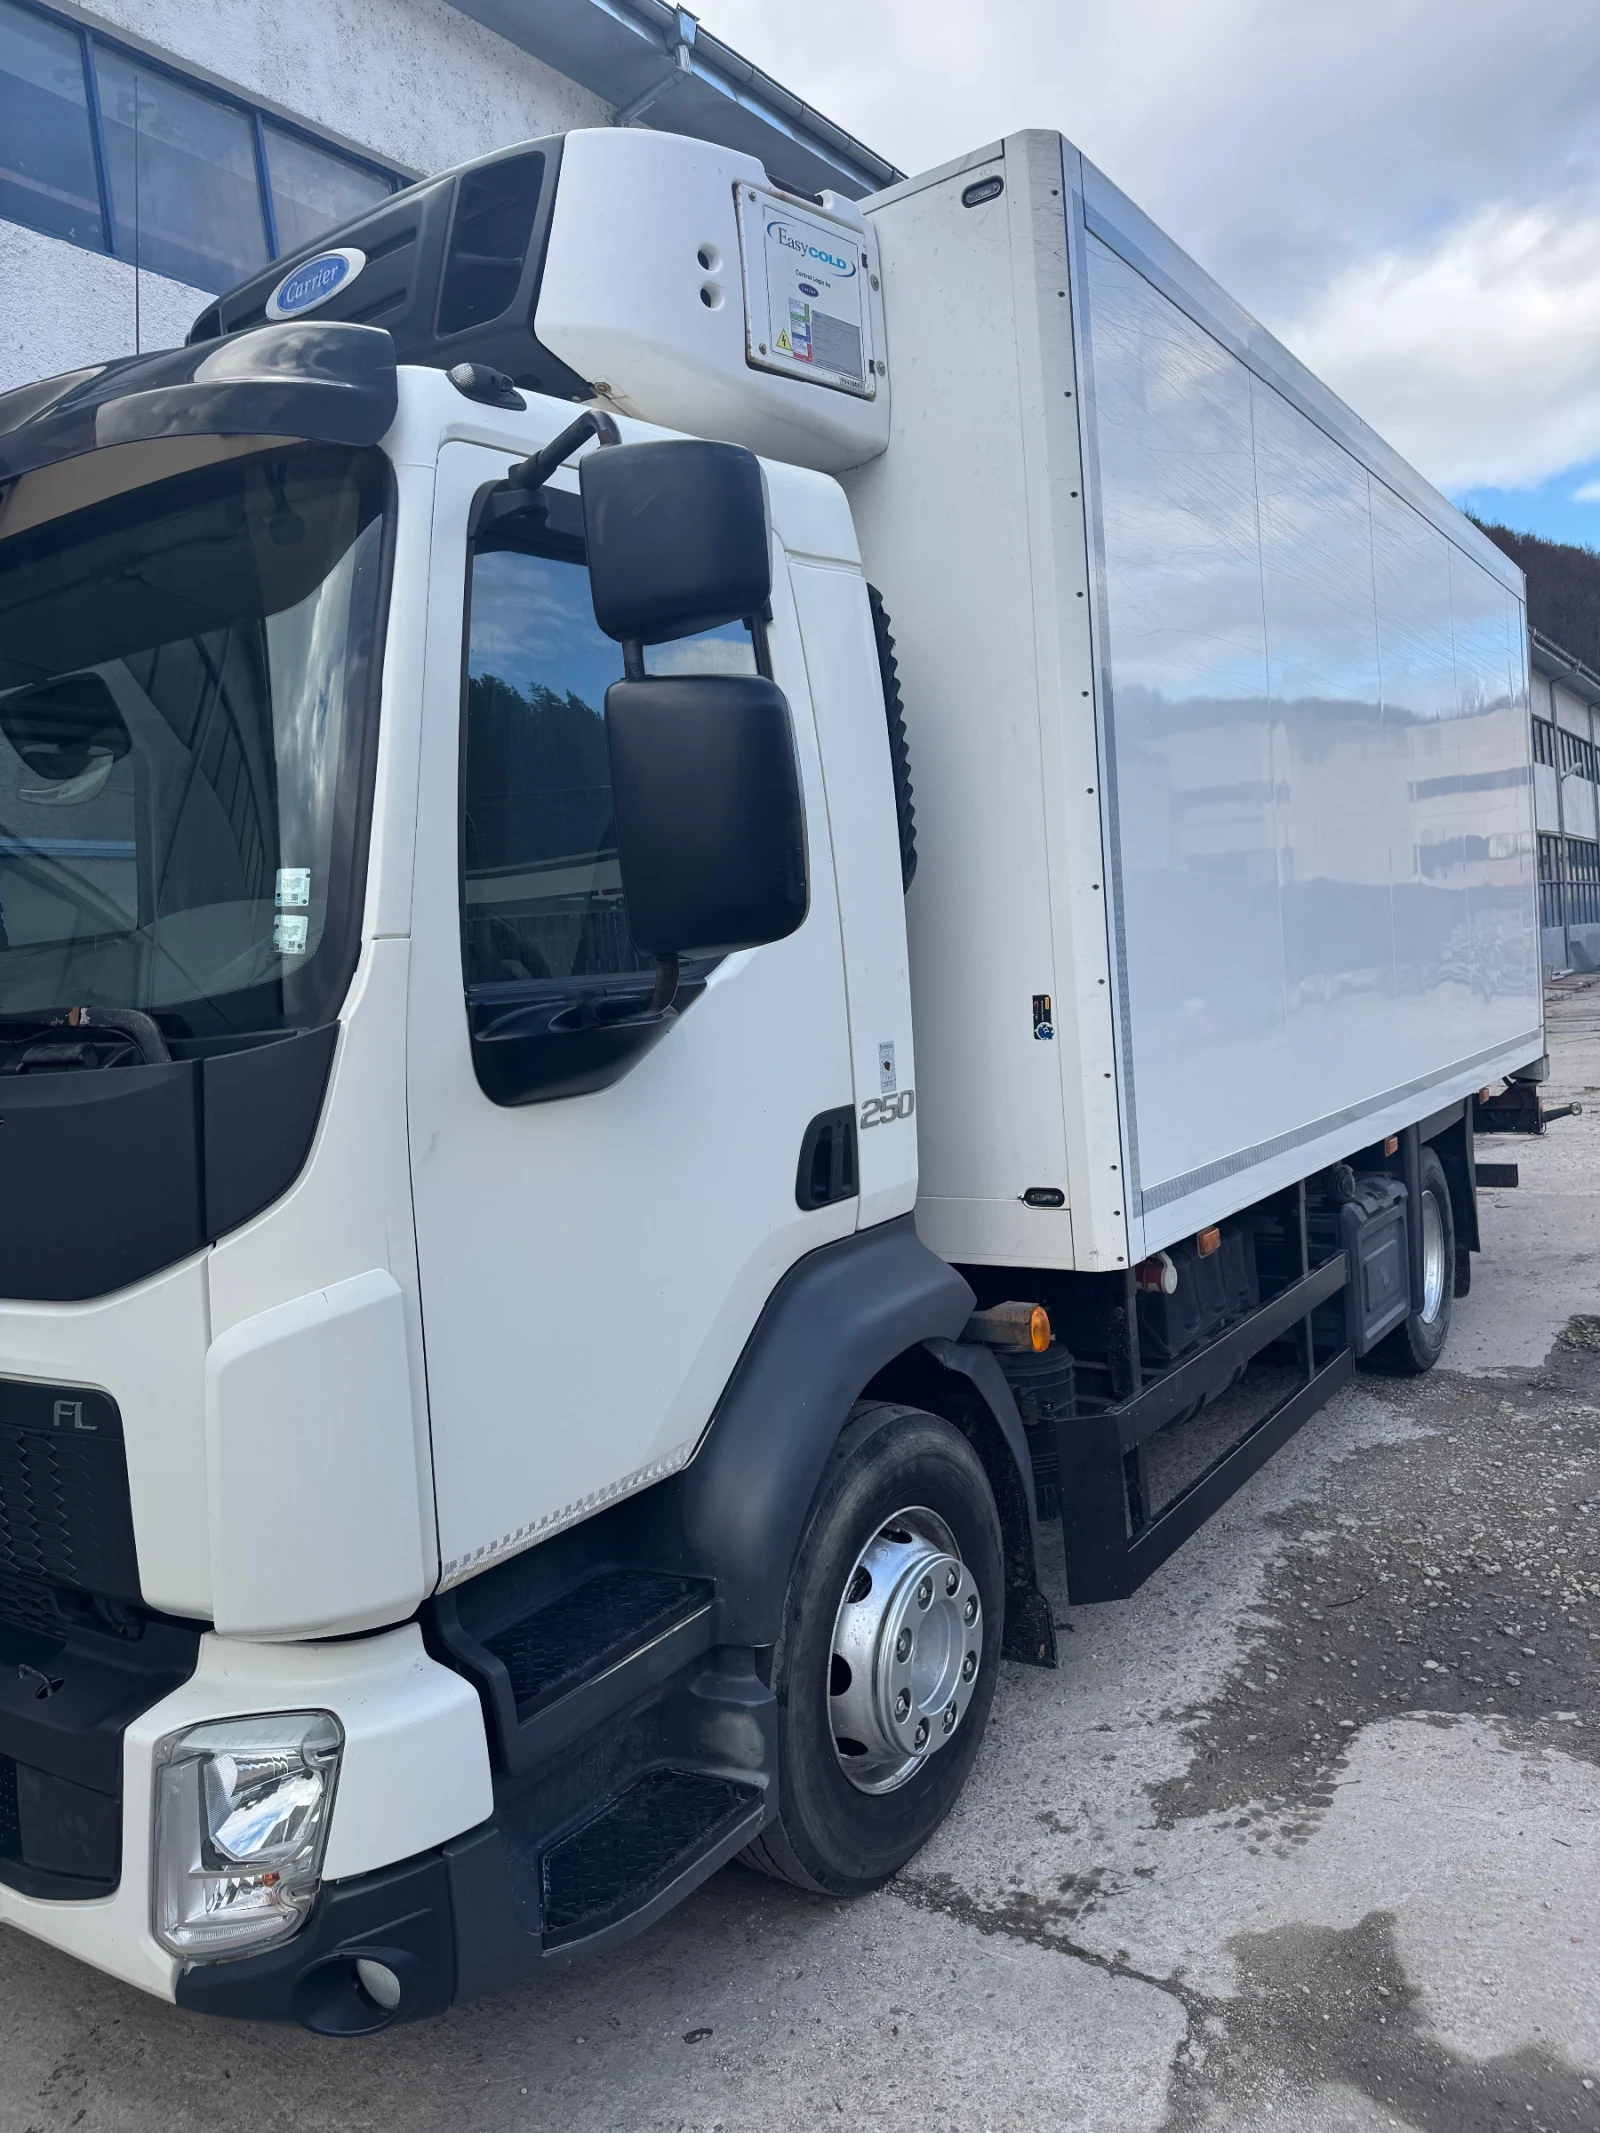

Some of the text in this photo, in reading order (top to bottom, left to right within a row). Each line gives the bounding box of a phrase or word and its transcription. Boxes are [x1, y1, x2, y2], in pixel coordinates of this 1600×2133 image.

[286, 265, 339, 303] Carrier
[795, 269, 831, 289] Control Logic by
[860, 1089, 915, 1130] 250
[53, 1399, 98, 1431] FL
